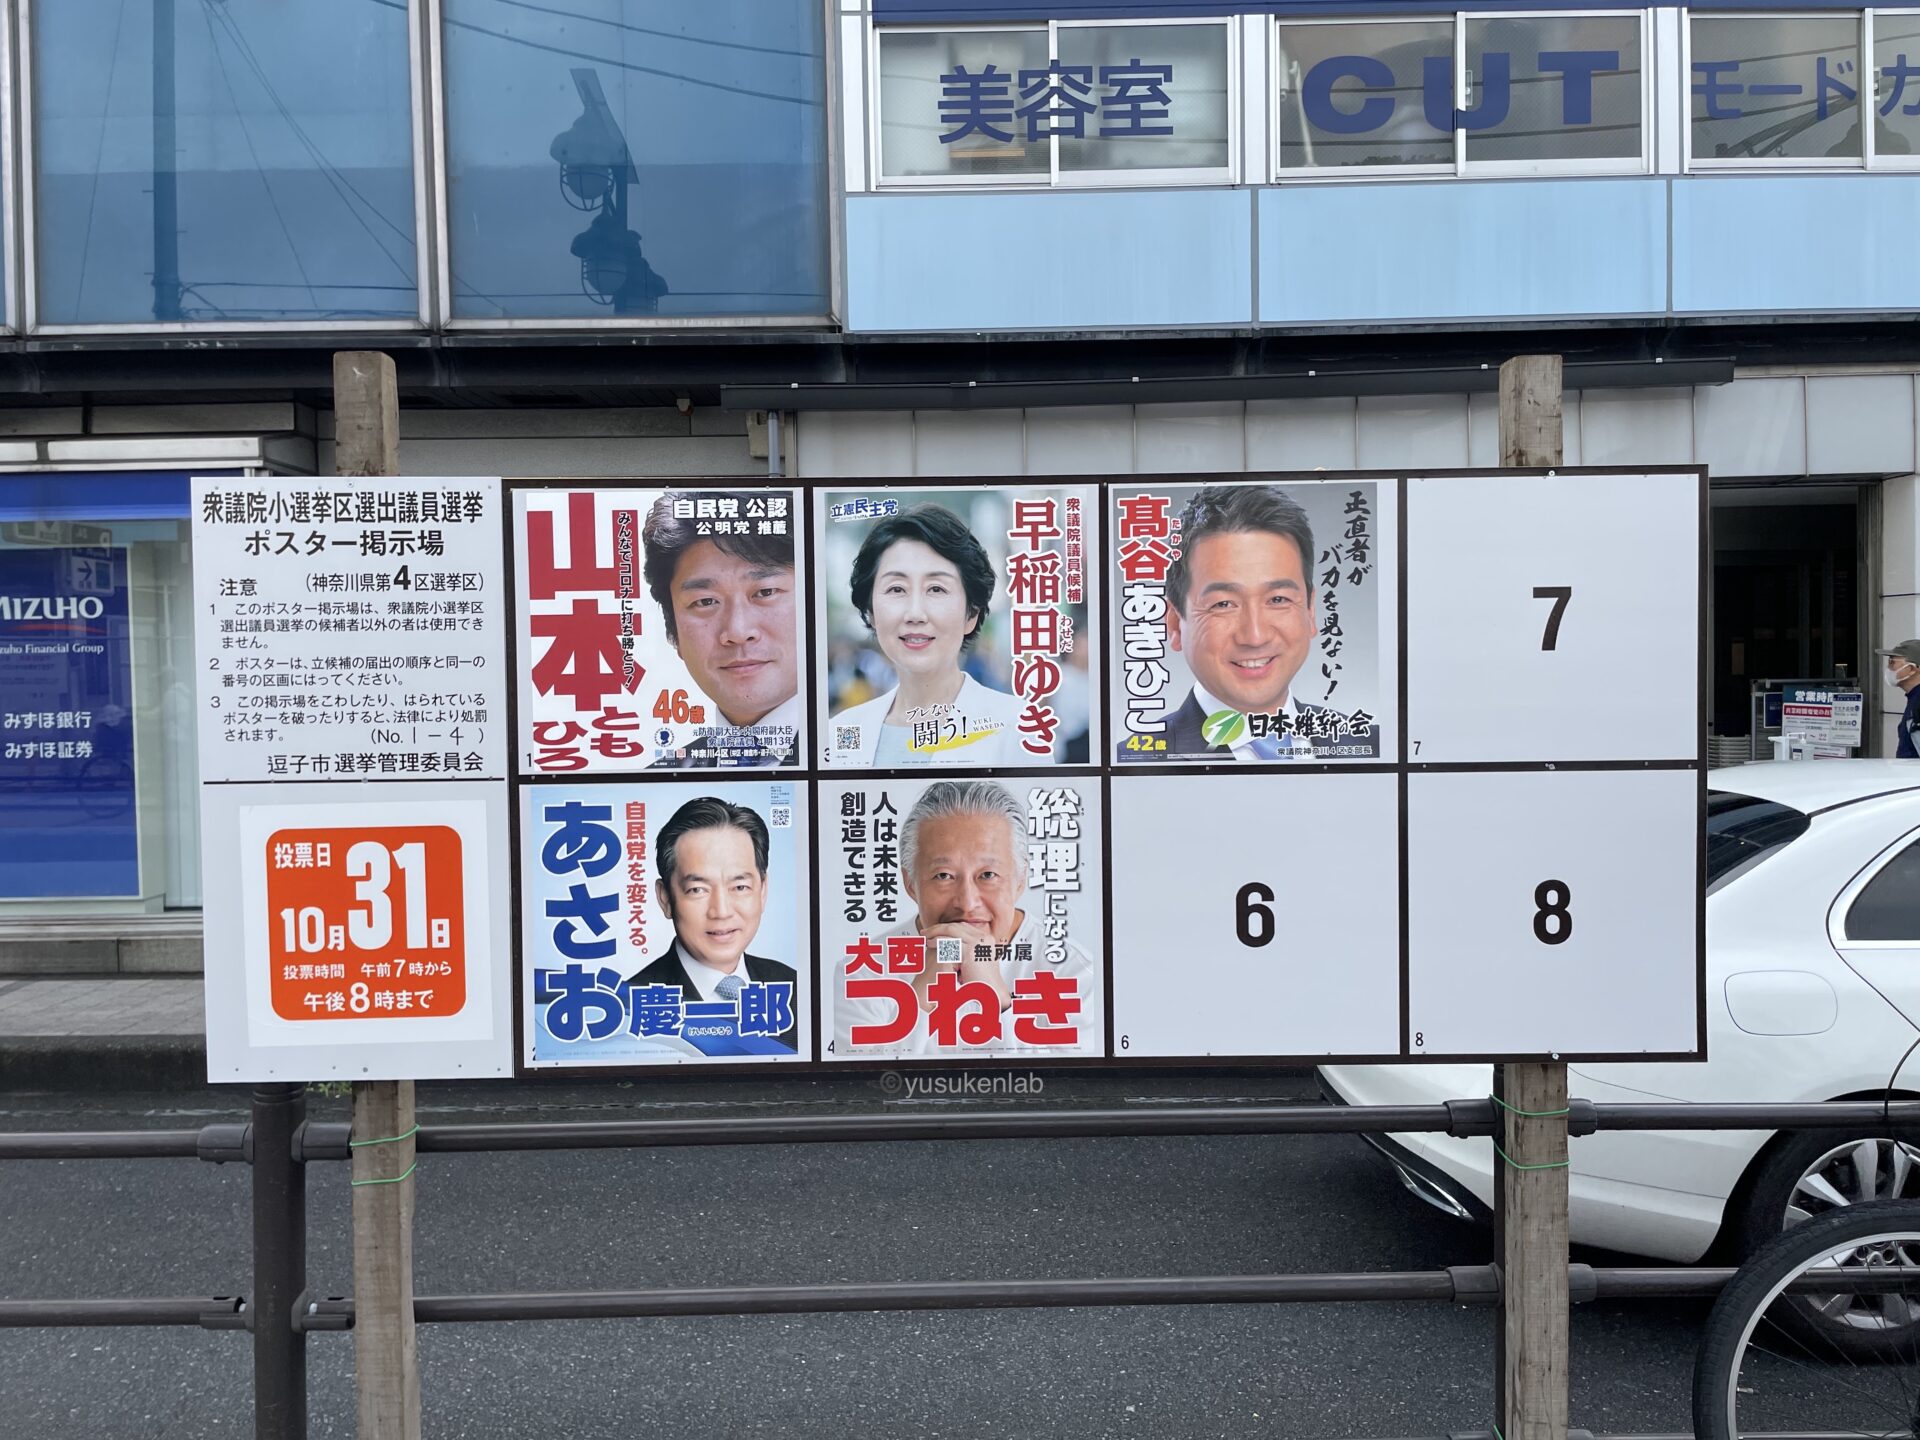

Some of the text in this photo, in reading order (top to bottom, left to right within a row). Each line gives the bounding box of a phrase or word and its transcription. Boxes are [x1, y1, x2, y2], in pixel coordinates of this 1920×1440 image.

[937, 58, 1174, 145] 美容室
[1302, 51, 1620, 134] CUT
[203, 491, 483, 523] 衆議院小選挙区選出議員選挙
[673, 498, 787, 519] 自民党 公認
[831, 498, 898, 518] 立憲民主党
[696, 520, 787, 536] 公明党 推薦
[1171, 519, 1182, 560] たかや
[1343, 490, 1372, 586] 正直者が
[245, 530, 444, 556] ポスター掲示場
[1066, 498, 1081, 603] 衆議院議員候補
[220, 578, 258, 596] 注意
[306, 565, 484, 592] （神奈川県第4区選挙区）
[235, 602, 484, 616] このポスター掲示場は、衆議院小選挙区
[618, 512, 638, 688] みんなでコロナに打ち勝とう!
[220, 619, 484, 632] 選出議員選挙の候補者以外の者は使用でき
[1008, 499, 1061, 754] 早稲田ゆき
[1318, 544, 1344, 701] バカを見ない!
[1532, 586, 1573, 652] 7
[222, 636, 270, 649] ません。
[1060, 616, 1072, 653] わせだ
[25, 644, 68, 653] Financial
[72, 643, 104, 655] Group
[236, 656, 485, 671] ポスターは、立候補の届出の順序と同一の
[222, 673, 405, 688] 番号の区画にはってください。
[238, 694, 485, 708] この掲示場をこわしたり、はられている
[653, 689, 705, 724] 46歳
[907, 704, 961, 722] ブレない、
[4, 711, 91, 729] みずほ銀行
[223, 710, 487, 725] ポスターを破ったりすると、法律により処罰
[972, 722, 1005, 732] WASEDA
[973, 718, 992, 726] YUKI
[1248, 709, 1374, 742] 日本維新の会
[225, 729, 285, 742] されます。
[707, 736, 793, 747] 衆議院議員 4期13年
[913, 716, 967, 749] 闘う!
[1126, 735, 1167, 752] 42歳
[5, 741, 93, 759] みずほ証券
[526, 753, 533, 767] 1
[691, 749, 728, 758] 神奈川4区
[1413, 741, 1422, 756] 7
[268, 753, 483, 774] 逗子市選挙管理委員会
[274, 842, 331, 869] 投票日
[840, 791, 867, 922] 創造できる
[872, 791, 898, 922] 人は未来を
[626, 801, 648, 955] 自民党を変える。
[1027, 787, 1081, 964] 総理になる
[541, 800, 625, 1042] あさお
[1235, 881, 1275, 948] 6
[1532, 878, 1573, 946] 8
[845, 937, 926, 975] 大西
[974, 943, 1032, 962] 無所属
[283, 958, 452, 980] 投票時間 午前7時から
[304, 982, 434, 1013] 午後8時まで
[845, 971, 1083, 1047] つねき
[628, 983, 794, 1038] 慶一郎
[1121, 1035, 1130, 1050] 6
[1415, 1032, 1424, 1047] 8
